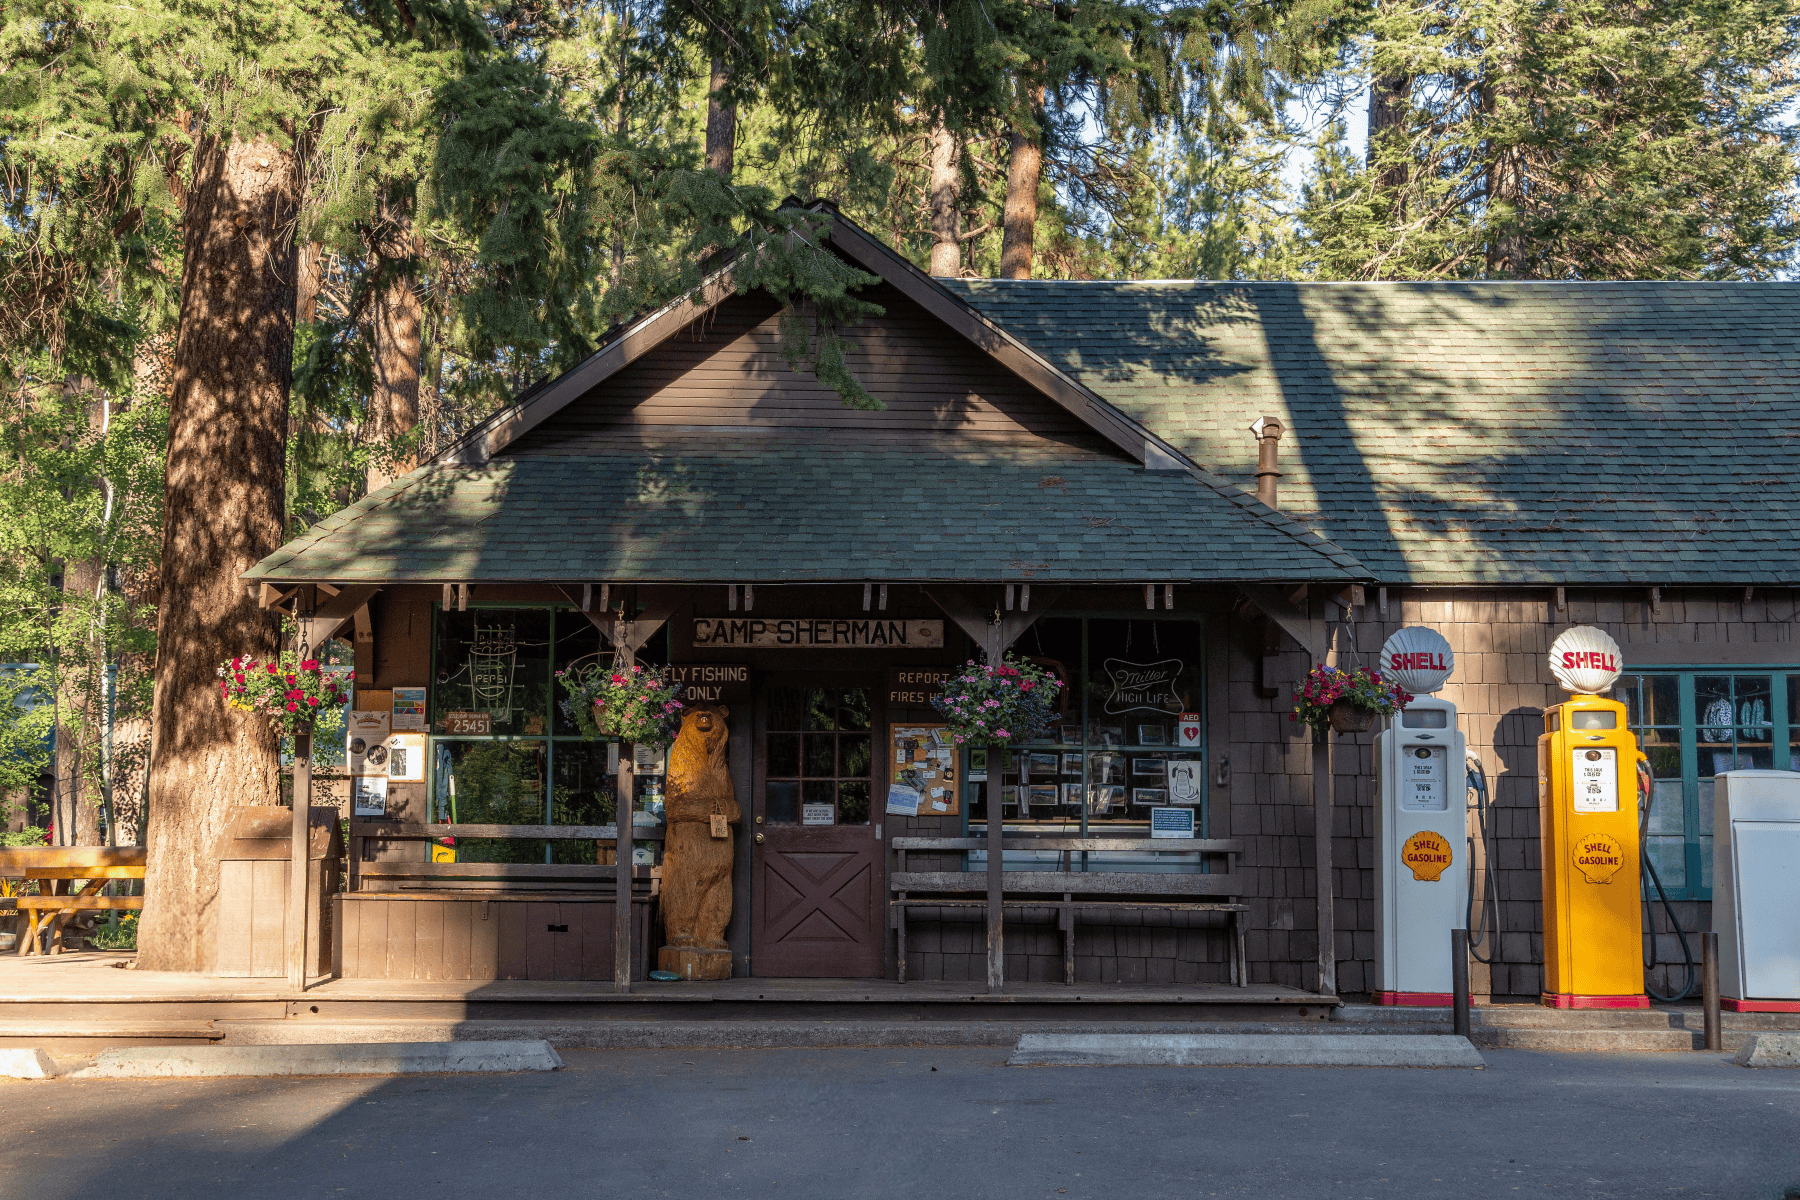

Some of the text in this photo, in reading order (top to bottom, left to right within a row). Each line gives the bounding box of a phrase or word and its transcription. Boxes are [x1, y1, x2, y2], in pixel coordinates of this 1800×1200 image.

[694, 620, 767, 643] CAMP
[1391, 652, 1447, 671] SHELL
[1562, 651, 1617, 673] SHELL
[475, 674, 508, 684] PEPSI
[662, 667, 747, 682] FLY FISHING
[899, 672, 950, 684] REPORT
[1116, 670, 1168, 685] Miller
[687, 686, 722, 700] ONLY
[890, 691, 924, 702] FIRES
[1117, 691, 1170, 704] HIGH LIFE
[453, 719, 490, 733] 25451
[1413, 840, 1440, 852] SHELL
[1584, 843, 1611, 854] SHELL
[1407, 853, 1448, 863] GASOLINE
[1578, 856, 1619, 866] GASOLINE
